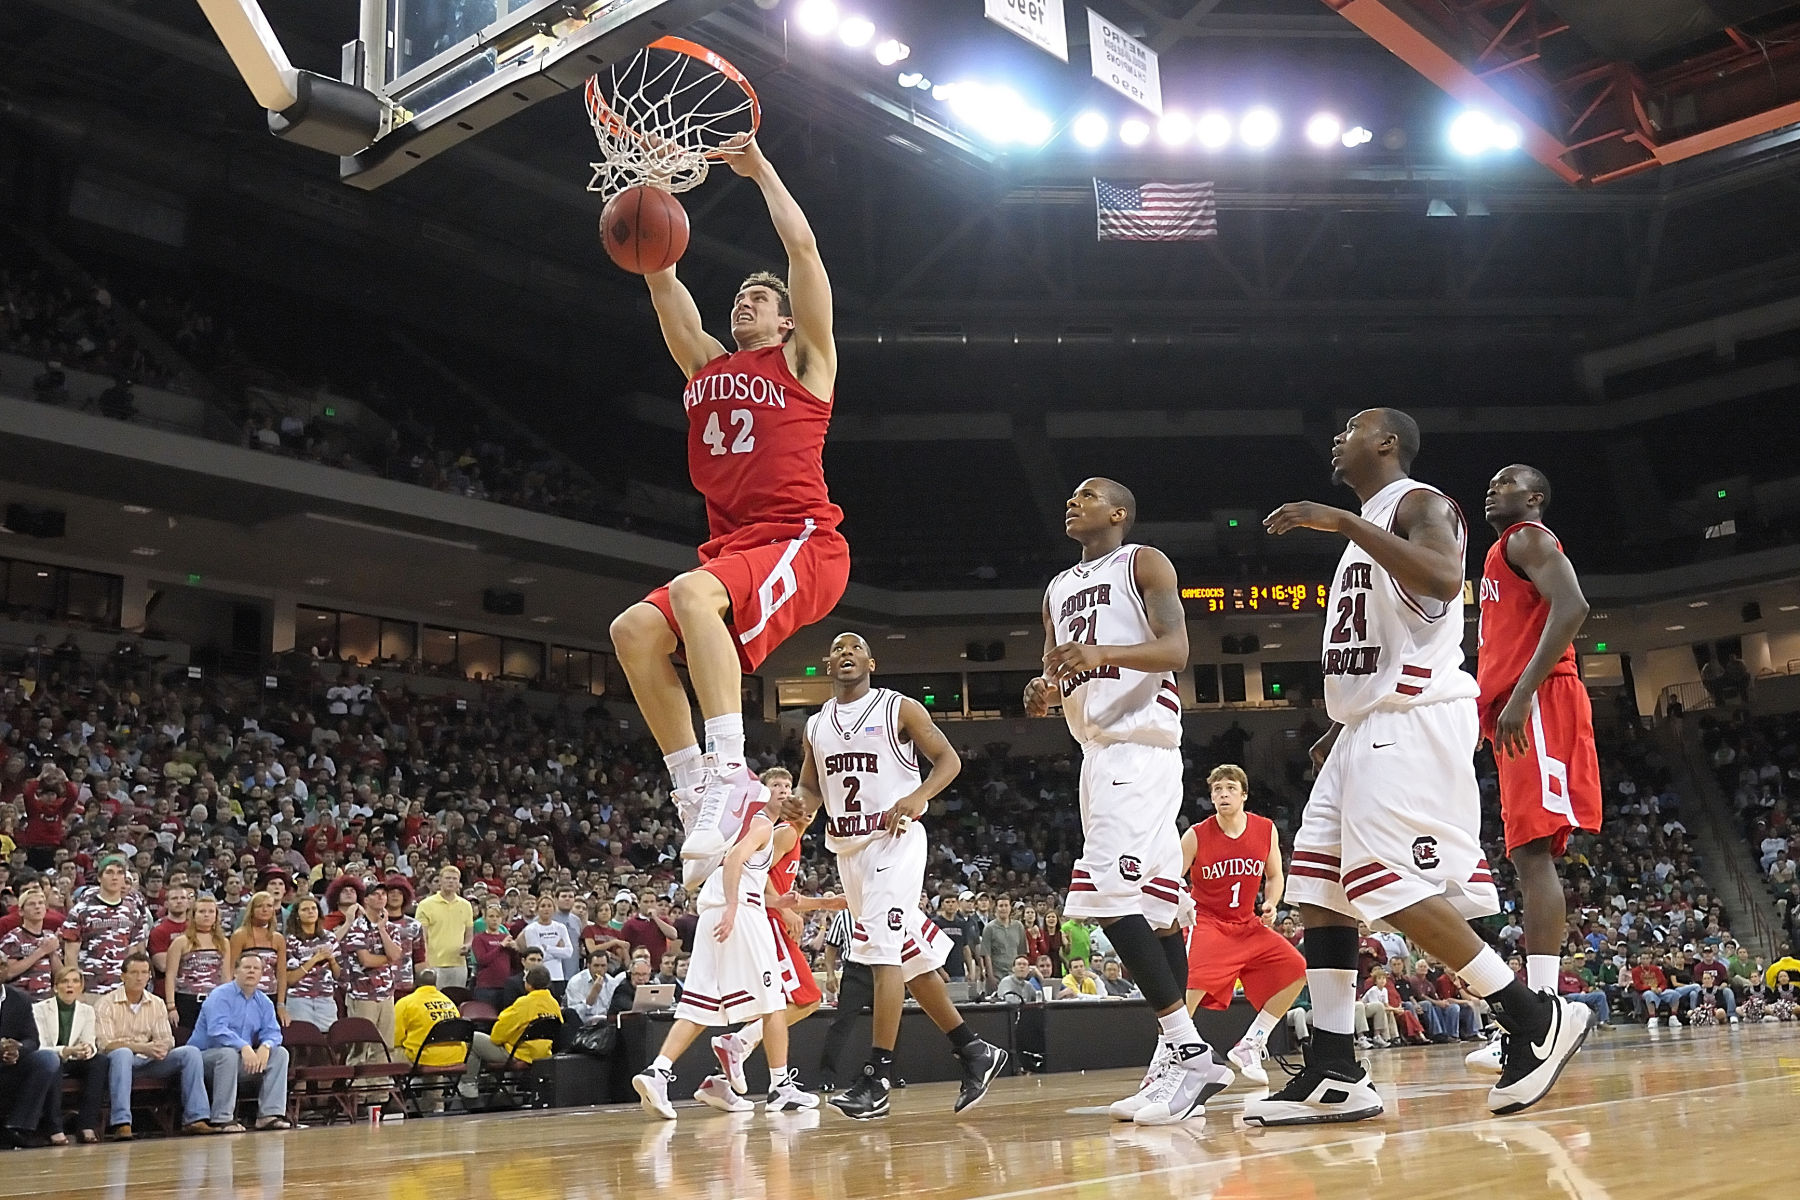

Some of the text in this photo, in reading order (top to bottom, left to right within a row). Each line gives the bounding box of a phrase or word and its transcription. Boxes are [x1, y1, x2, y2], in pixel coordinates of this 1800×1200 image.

[702, 409, 755, 456] 42
[1059, 584, 1111, 624] SOUTH
[1181, 588, 1225, 598] GAMECOCKS
[1249, 599, 1258, 609] 4
[1251, 586, 1258, 598] 3
[1271, 585, 1306, 599] 16:48
[1292, 598, 1300, 610] 2
[1209, 599, 1224, 611] 31
[1069, 609, 1097, 645] 21
[1330, 593, 1367, 643] 24
[825, 752, 878, 776] SOUTH
[843, 776, 861, 812] 2
[1229, 881, 1241, 908] 1
